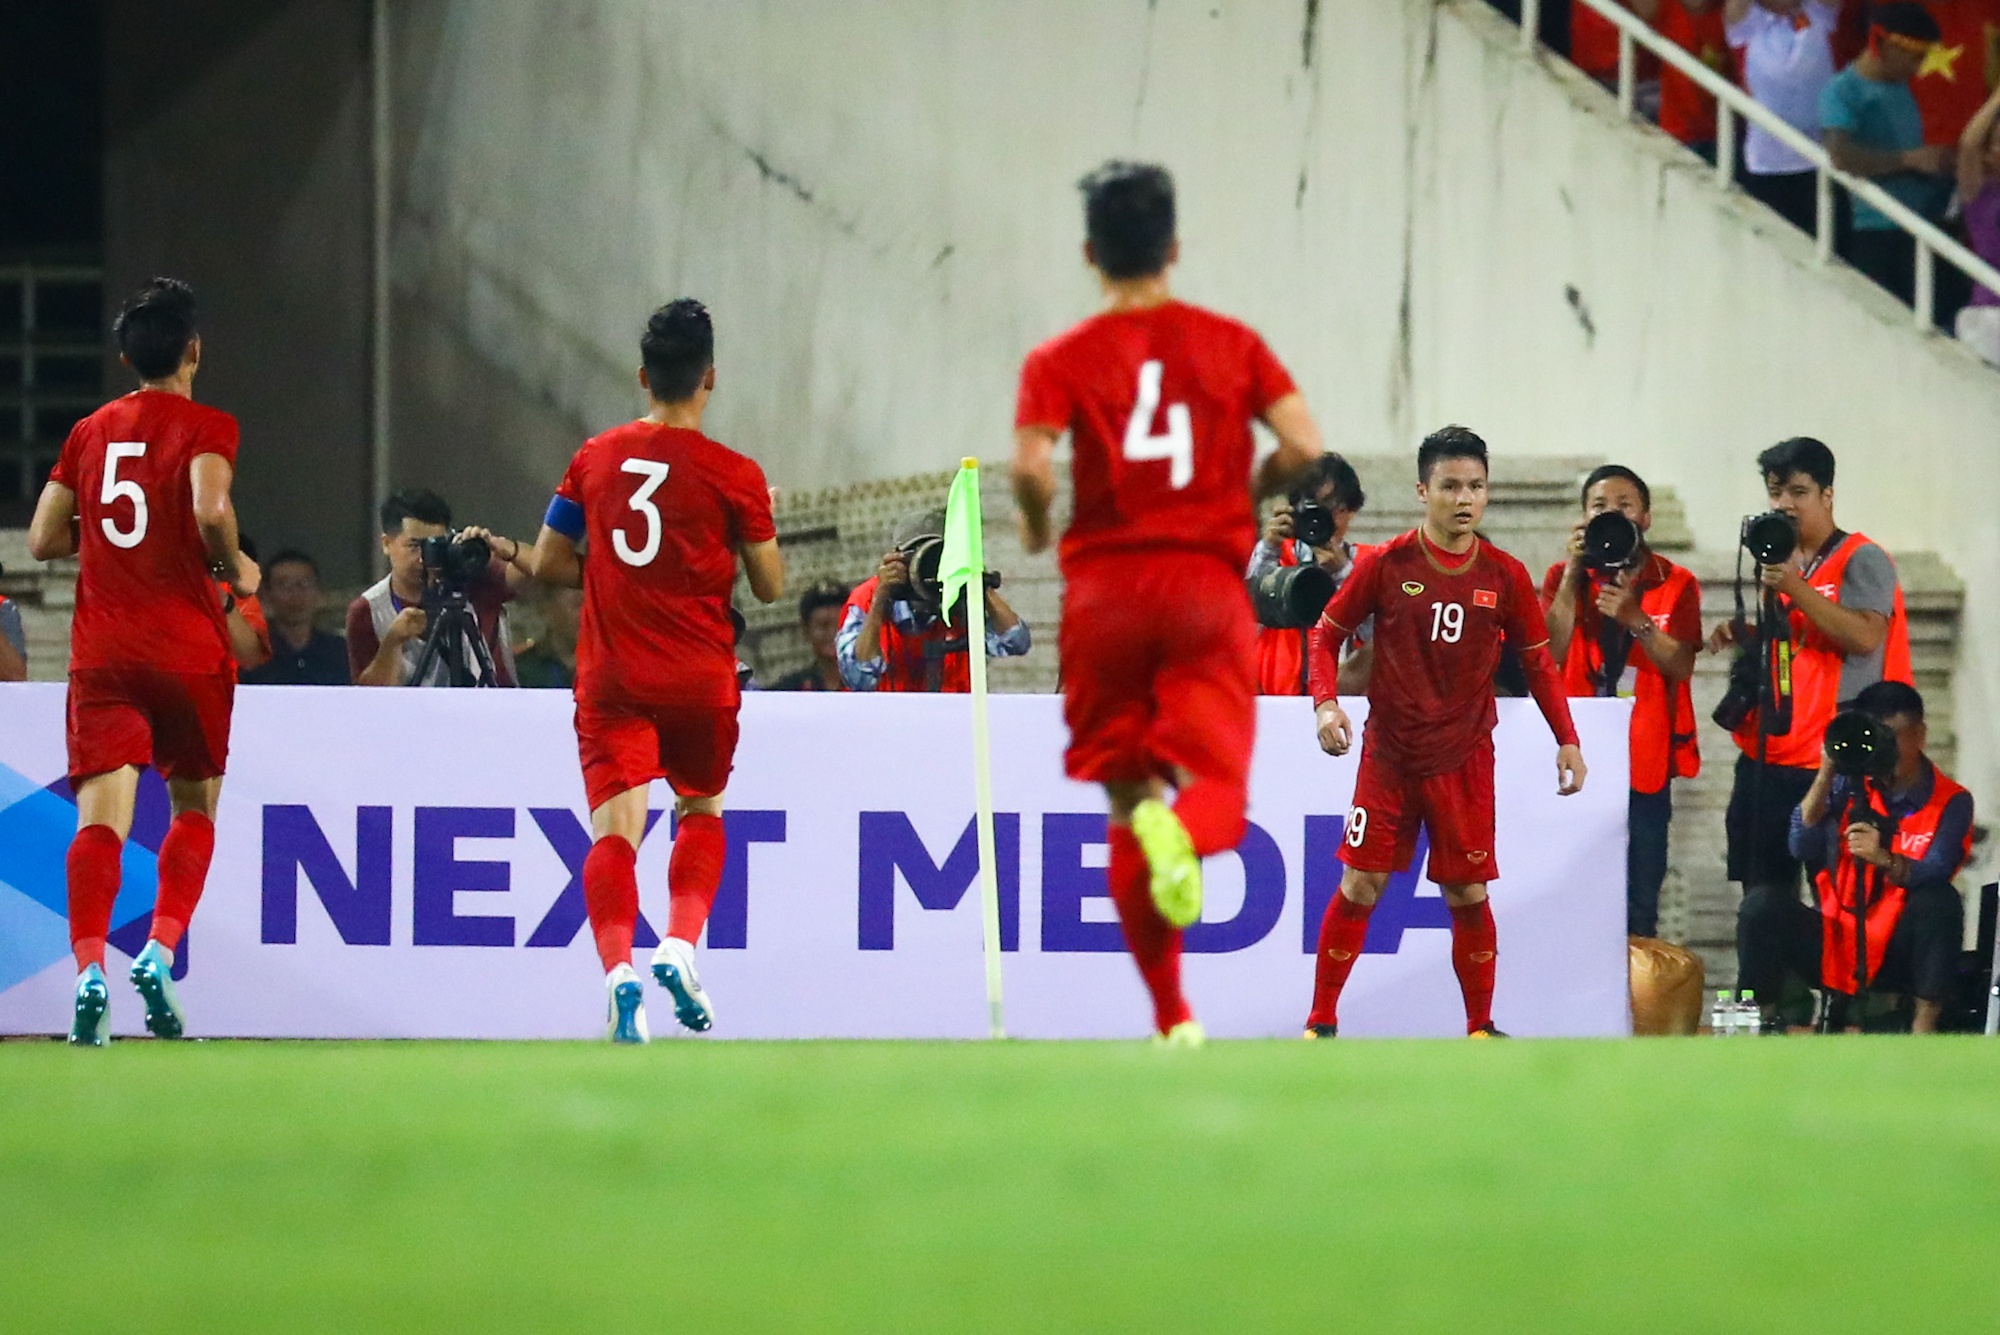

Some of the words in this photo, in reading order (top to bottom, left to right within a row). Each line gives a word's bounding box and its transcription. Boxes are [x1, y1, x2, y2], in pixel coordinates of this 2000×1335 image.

[1123, 360, 1194, 490] 4
[100, 442, 148, 549] 5
[612, 458, 670, 567] 3
[1431, 601, 1465, 643] 19
[261, 804, 787, 950] NEXT
